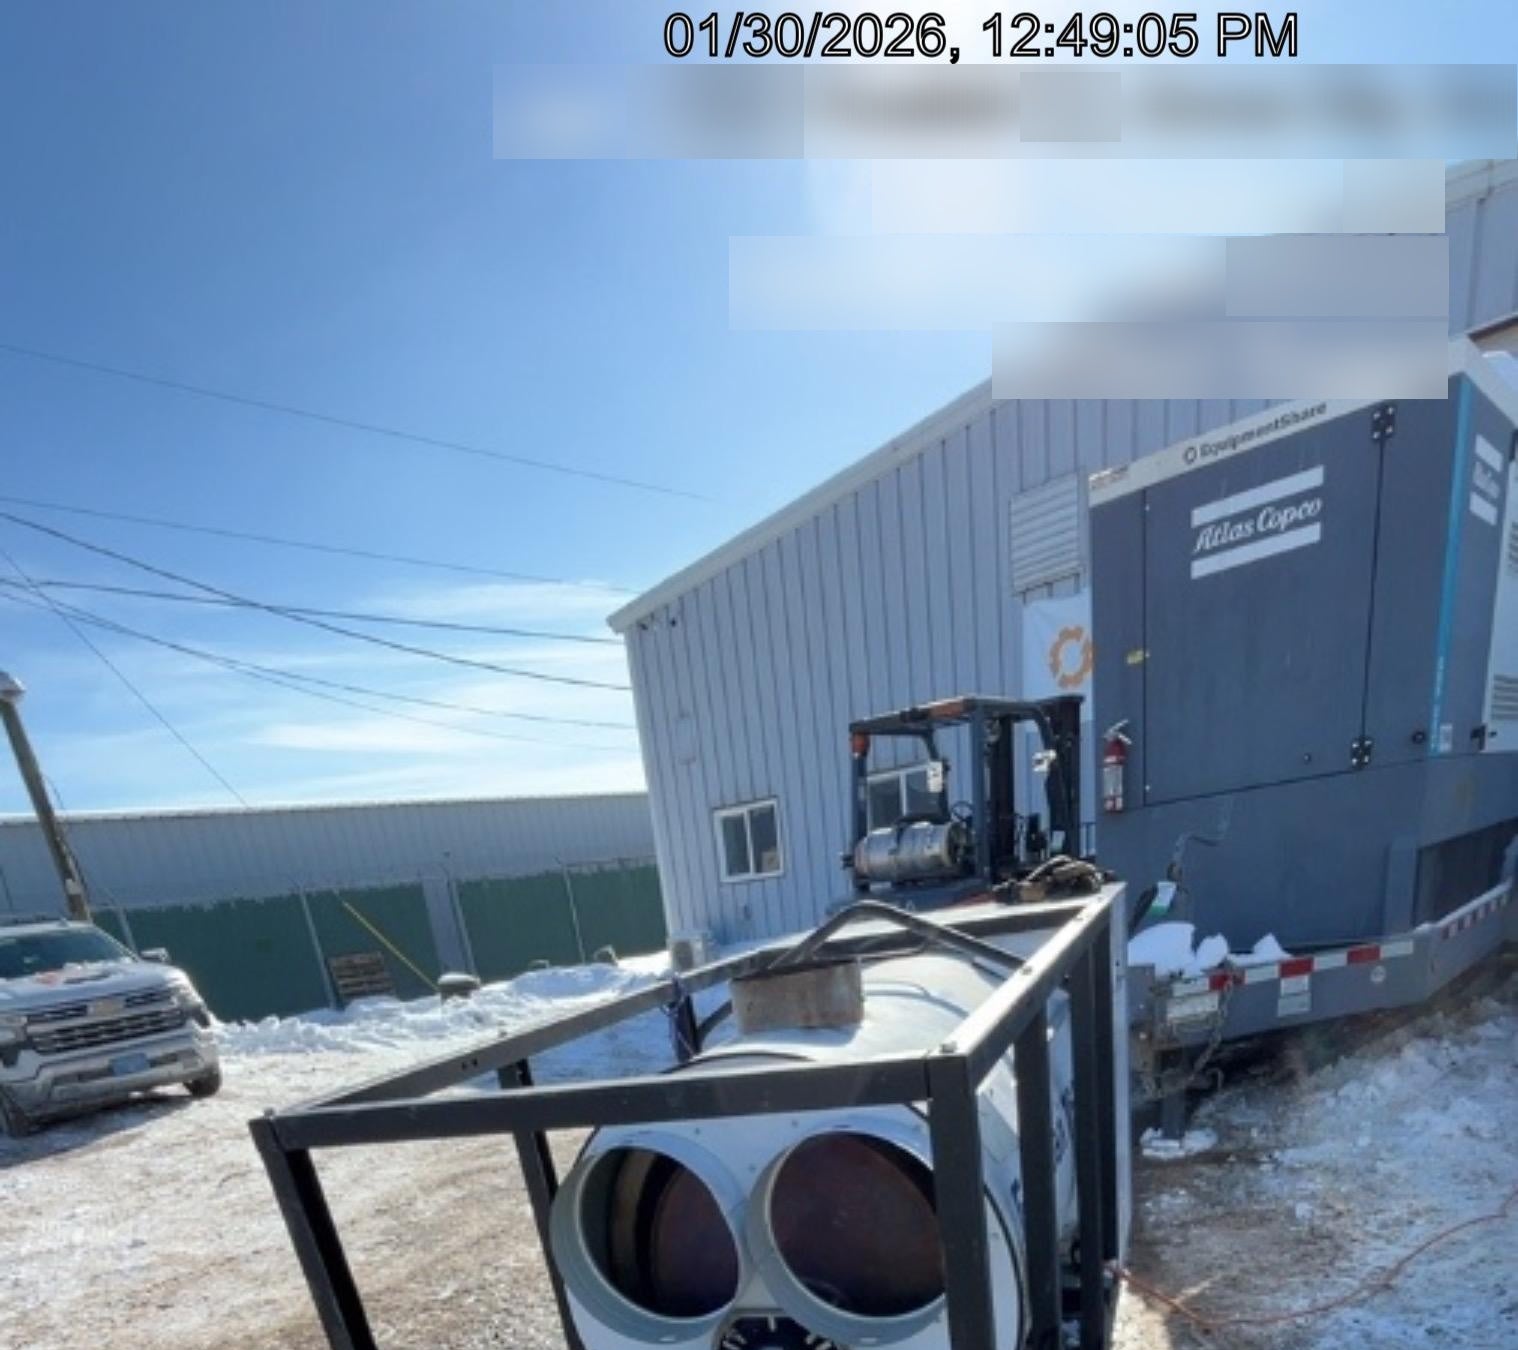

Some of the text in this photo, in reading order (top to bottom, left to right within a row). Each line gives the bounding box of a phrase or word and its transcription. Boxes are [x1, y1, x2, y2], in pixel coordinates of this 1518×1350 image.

[1200, 402, 1327, 458] EquipmentShare
[1193, 498, 1323, 553] Atlas Copco
